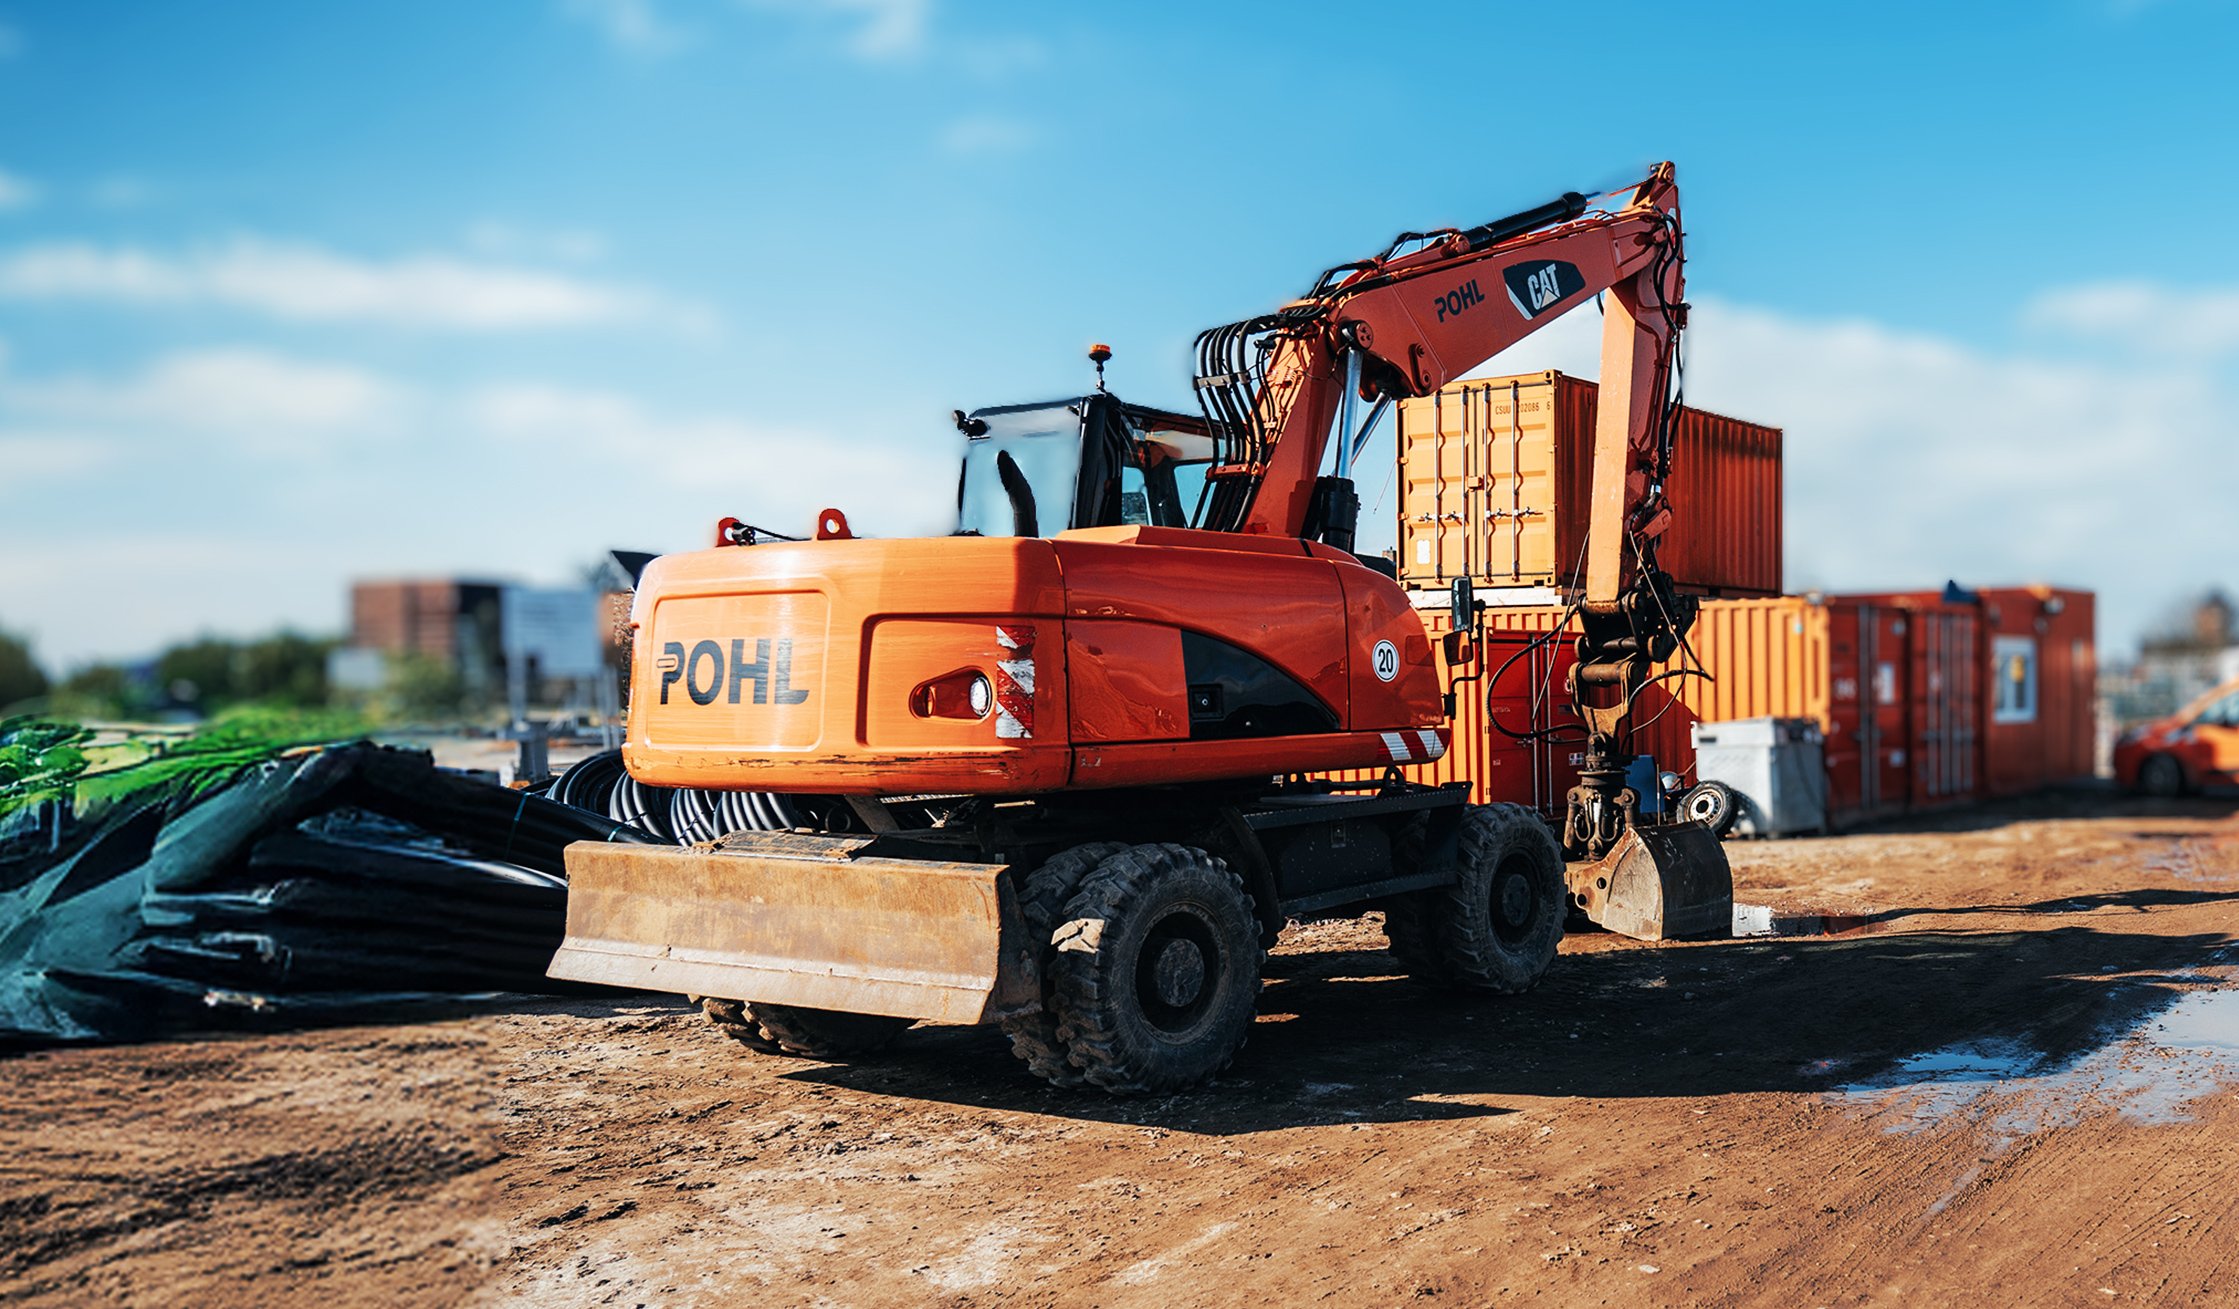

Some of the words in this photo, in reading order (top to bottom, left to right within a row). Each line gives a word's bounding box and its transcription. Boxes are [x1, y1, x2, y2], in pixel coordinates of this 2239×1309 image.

[1434, 279, 1485, 323] POHL
[1527, 263, 1561, 310] CAT
[657, 638, 810, 706] POHL
[1378, 648, 1394, 673] 20
